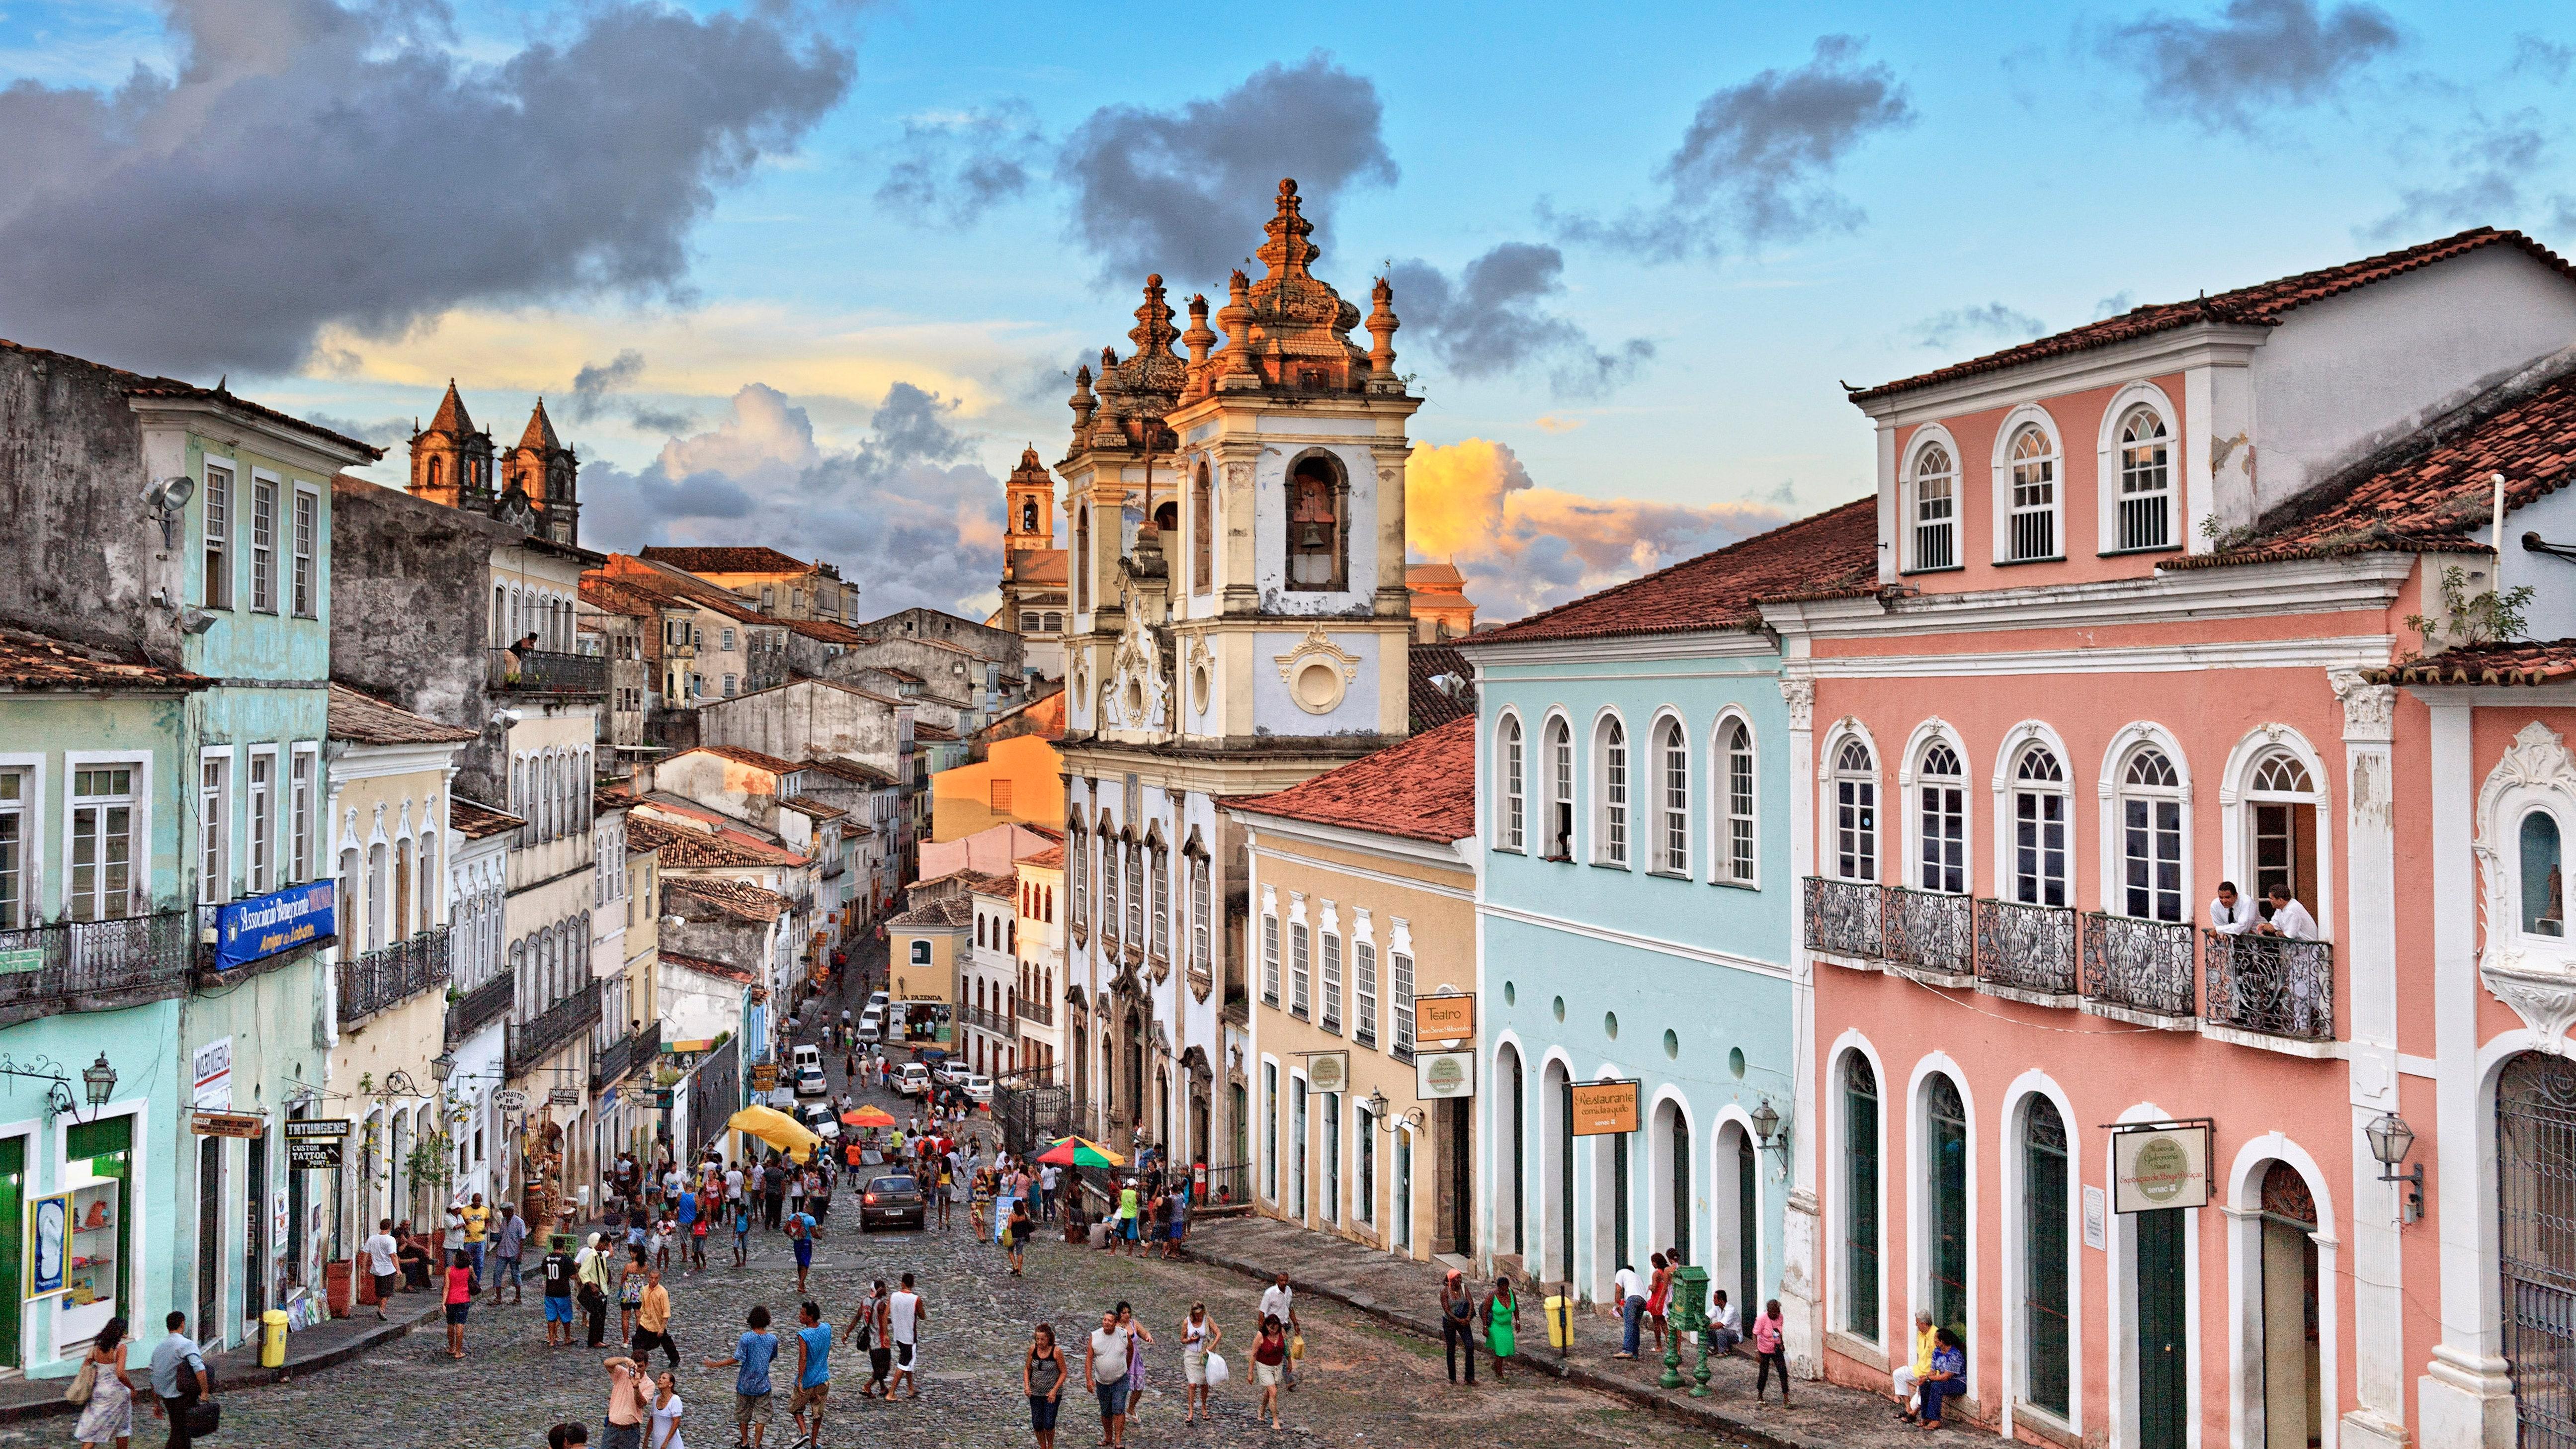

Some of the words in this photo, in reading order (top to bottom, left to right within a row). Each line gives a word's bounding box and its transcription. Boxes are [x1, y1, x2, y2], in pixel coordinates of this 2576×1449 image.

[1426, 1007, 1461, 1021] Teatro
[1575, 1093, 1634, 1106] Restaurante
[1581, 1105, 1606, 1115] comida
[1611, 1104, 1629, 1117] quilo
[292, 1152, 327, 1160] TATTOO
[547, 1263, 559, 1280] 10
